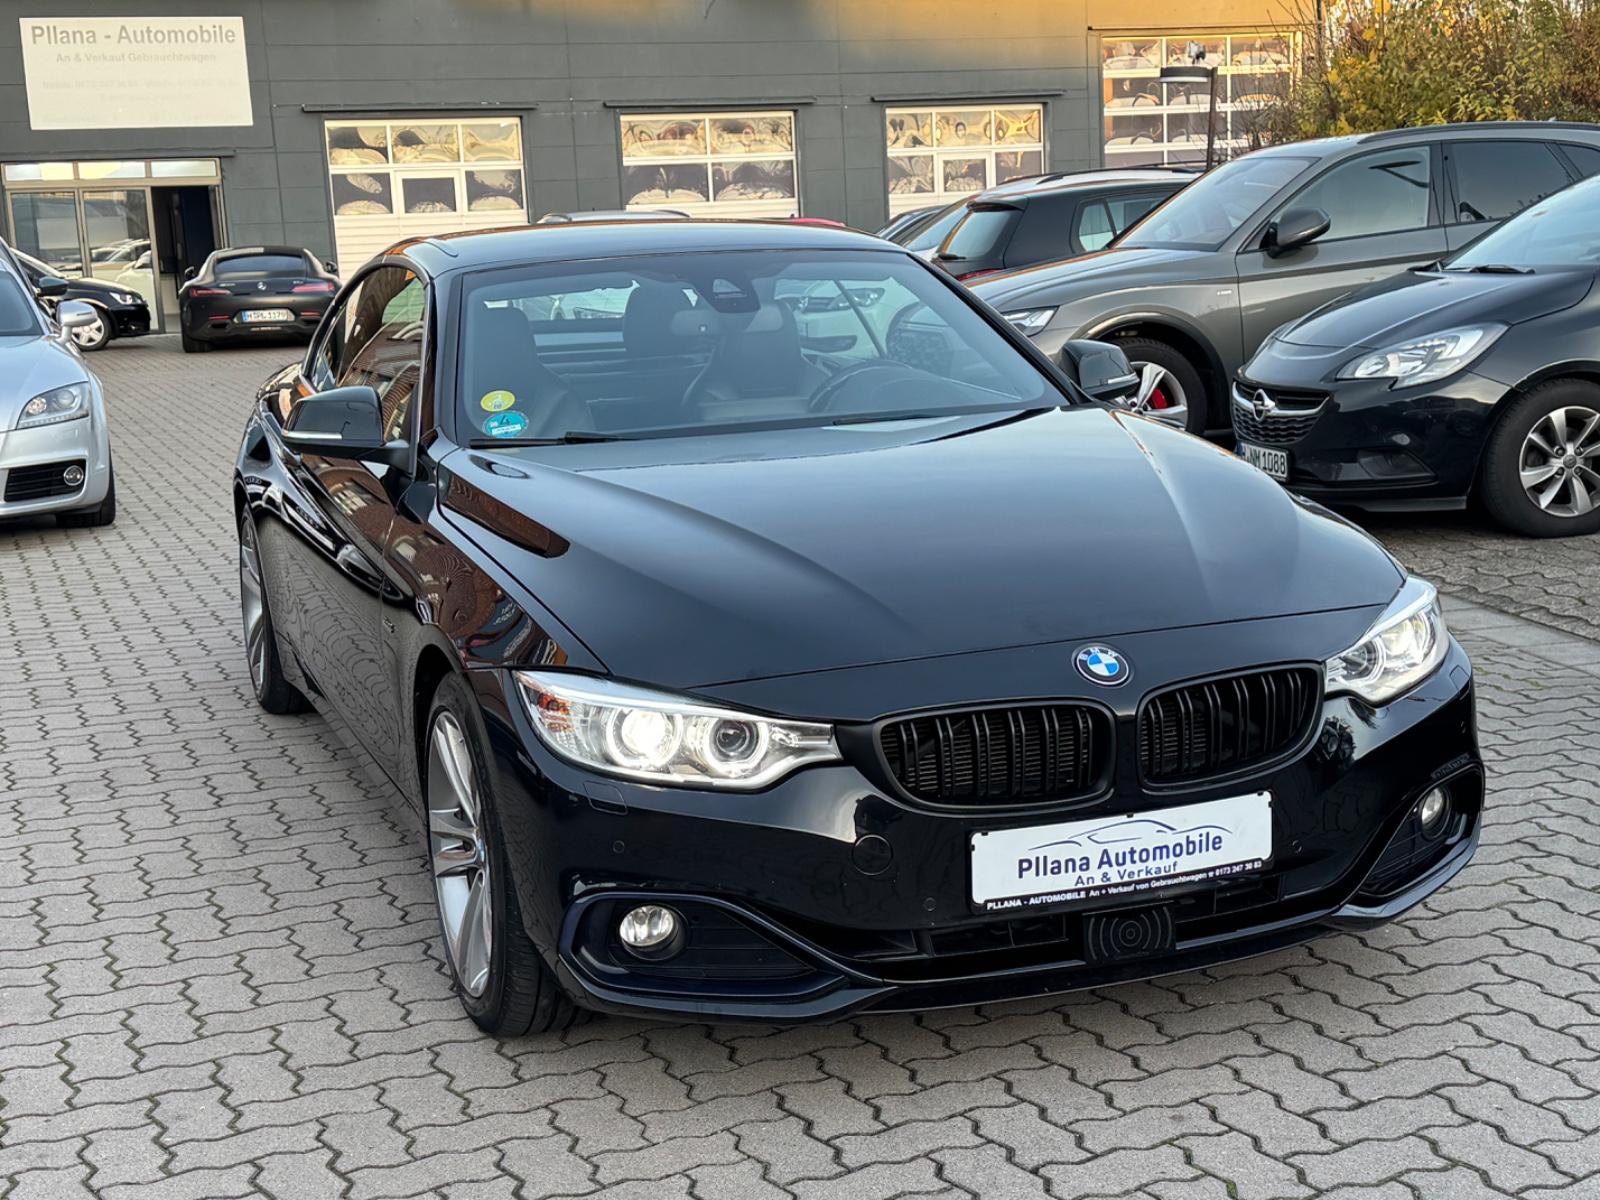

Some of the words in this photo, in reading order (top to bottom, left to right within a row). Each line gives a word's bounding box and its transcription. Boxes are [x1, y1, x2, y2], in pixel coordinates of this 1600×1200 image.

[31, 25, 97, 45] Pllana
[117, 24, 236, 45] Automobile
[56, 53, 71, 63] An
[74, 53, 82, 63] &
[84, 53, 125, 63] Verkauf
[128, 52, 217, 64] Gebrauchtwagen
[1262, 451, 1286, 475] 1088
[1018, 854, 1090, 879] Pllana
[1097, 832, 1224, 870] Automobile
[1074, 874, 1094, 887] An
[1101, 871, 1112, 883] &
[1117, 861, 1178, 880] Verkauf
[986, 899, 1022, 910] PLLANA
[1029, 891, 1086, 905] AUTOMOBILE
[1089, 889, 1100, 897] An
[1107, 883, 1135, 894] Verkauf
[1136, 882, 1149, 890] von
[1150, 872, 1208, 888] Gebrauchtwagen
[1215, 867, 1231, 876] 0173
